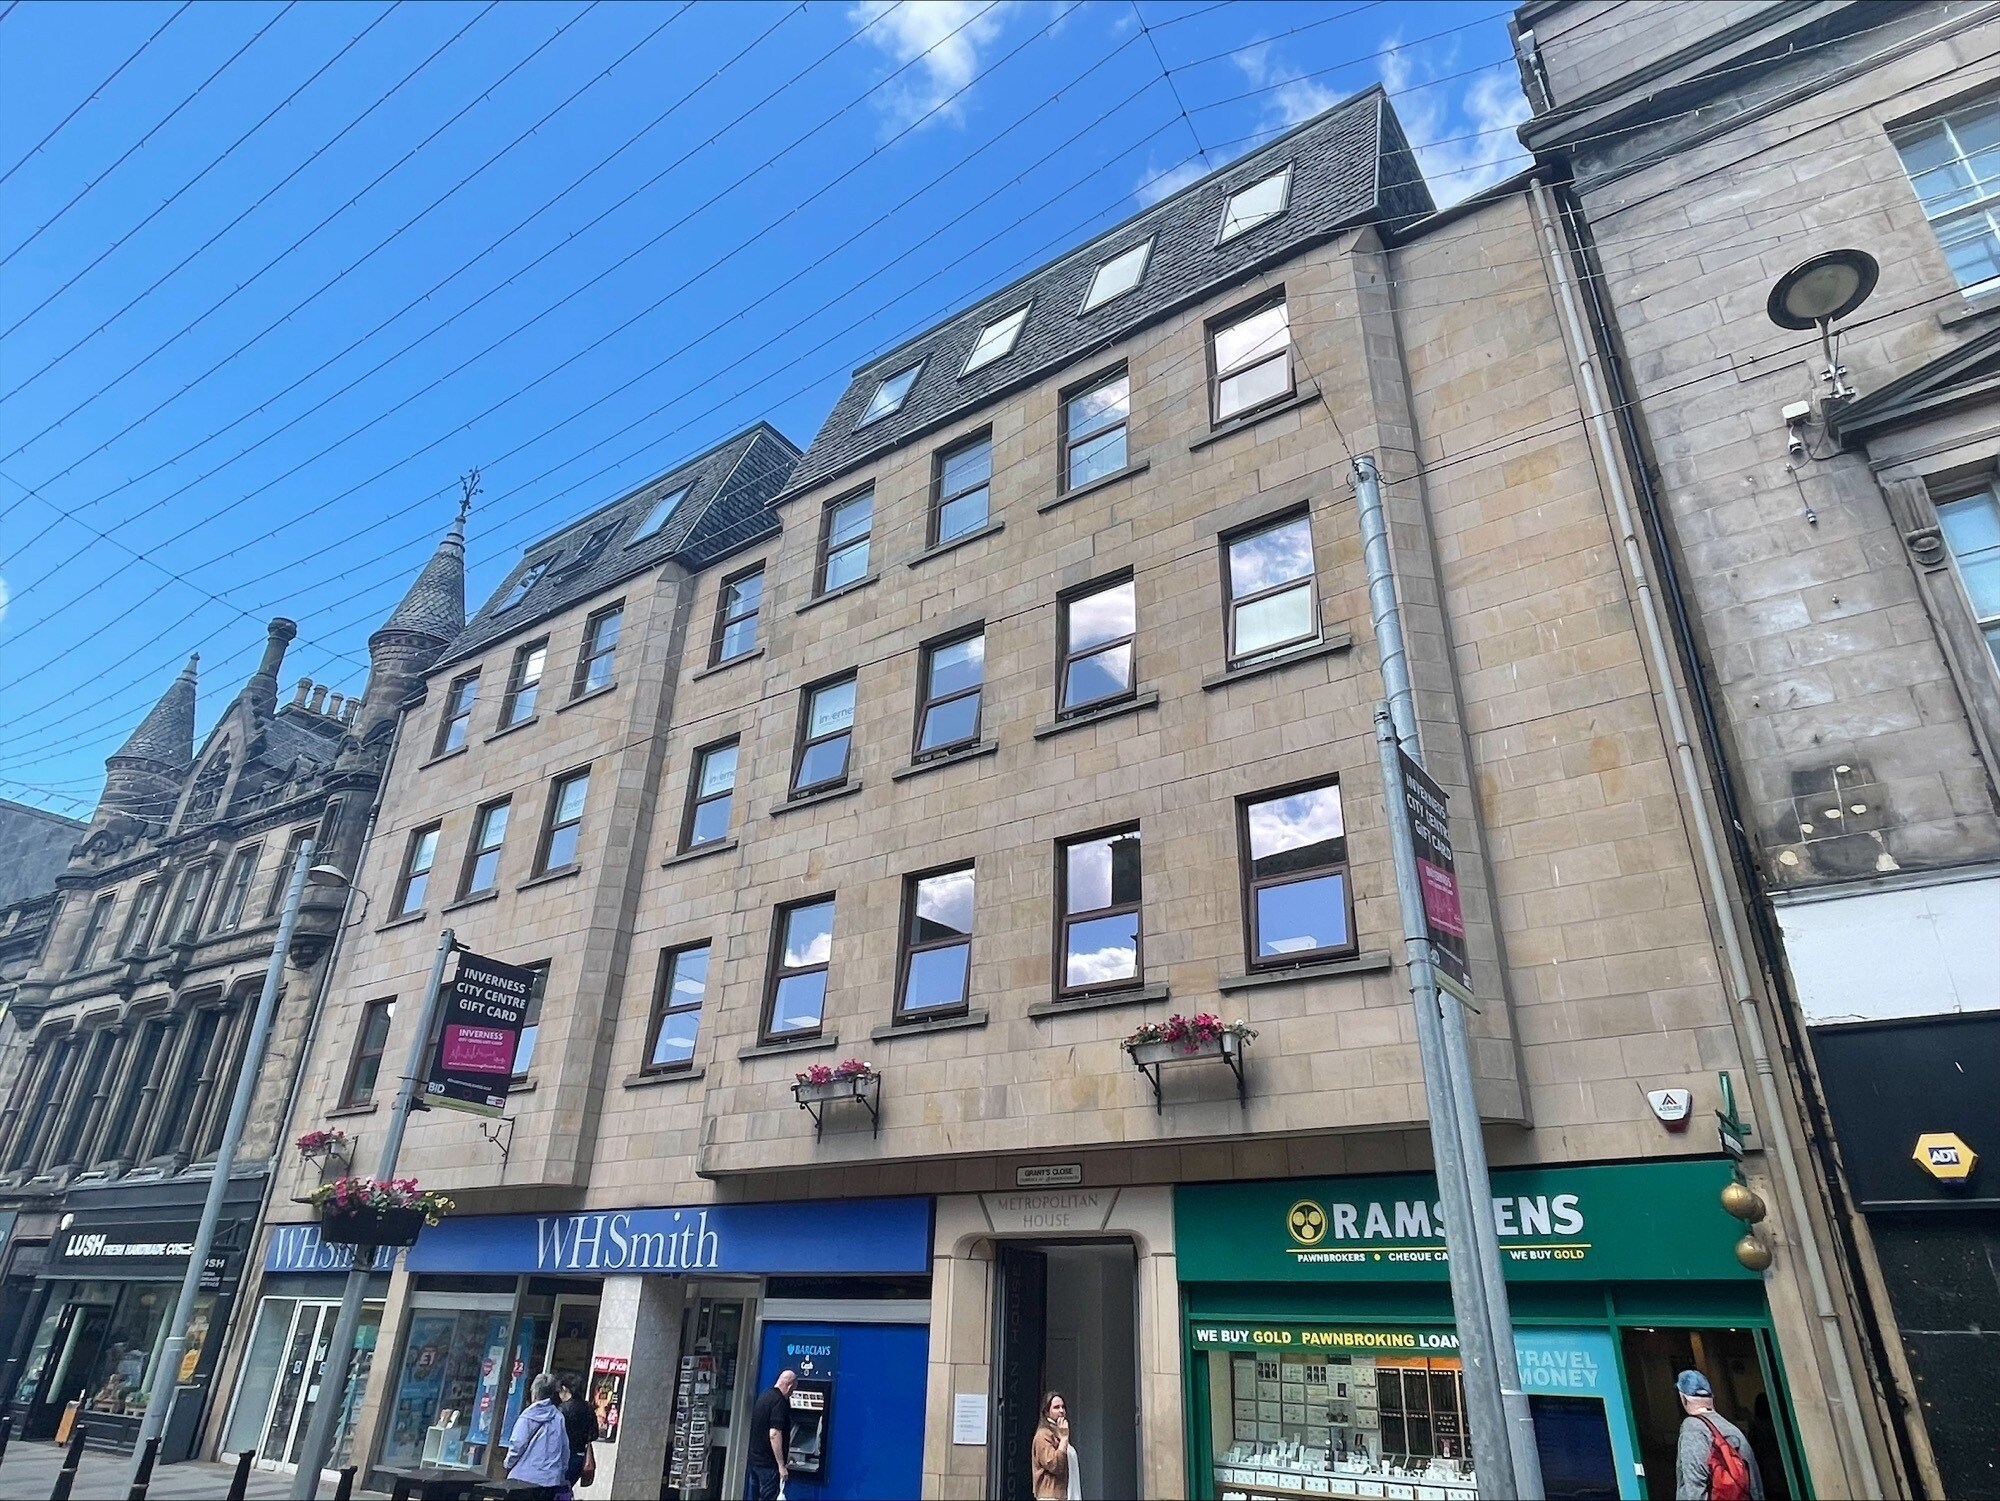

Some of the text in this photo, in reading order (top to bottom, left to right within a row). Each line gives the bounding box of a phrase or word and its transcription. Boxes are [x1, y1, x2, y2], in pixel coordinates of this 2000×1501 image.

[464, 967, 526, 994] INVERNESS
[456, 982, 526, 1010] CITY CENTRE
[459, 998, 518, 1022] GIFT CARD
[459, 1028, 503, 1041] INVERNESS
[427, 1082, 446, 1094] BID
[1931, 1149, 1958, 1163] ADT
[1024, 1167, 1073, 1177] GRANT'S CLOSE
[997, 1194, 1099, 1211] METROPOLITAN
[1023, 1213, 1071, 1229] HOUSE
[1332, 1194, 1585, 1239] RAMENS
[65, 1233, 107, 1257] LUSH
[275, 1226, 391, 1269] WHSmh
[536, 1210, 719, 1270] WHSmith
[204, 1258, 226, 1269] SH
[1297, 1249, 1585, 1263] PAWNBROKERS CHEQUE CA WE BUY GOLD
[1197, 1329, 1218, 1341] WE
[1220, 1330, 1250, 1342] BUY
[1253, 1331, 1292, 1343] GOLD
[1301, 1332, 1415, 1347] PAWNBROKING
[794, 1345, 831, 1356] BARCLAYS
[595, 1358, 628, 1373] Half price
[1006, 1361, 1019, 1501] OPOLITAN
